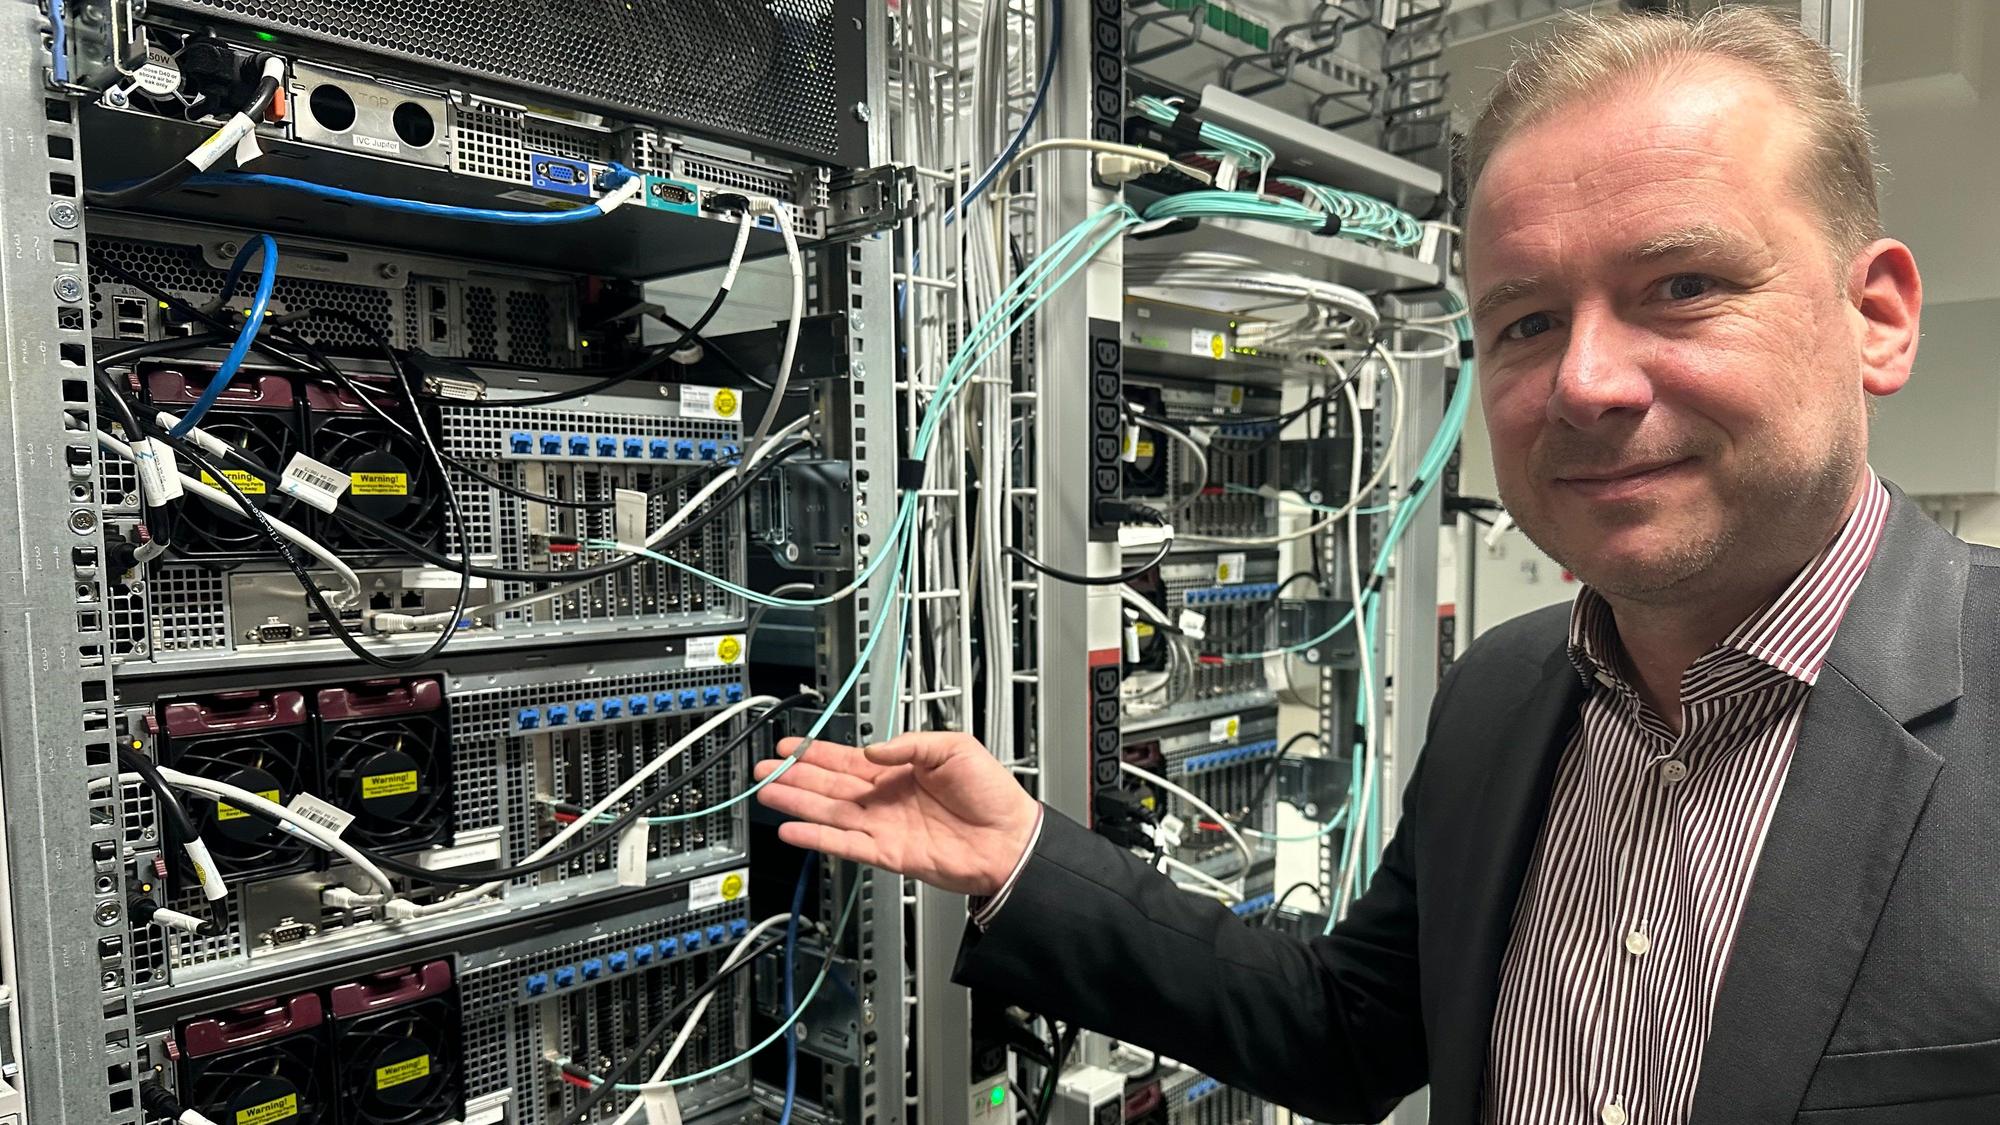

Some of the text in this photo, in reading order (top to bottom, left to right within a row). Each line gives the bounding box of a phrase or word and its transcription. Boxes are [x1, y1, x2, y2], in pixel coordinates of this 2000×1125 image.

[356, 136, 370, 146] IVC
[361, 474, 399, 484] Warning!
[372, 773, 409, 785] Warning!
[385, 1059, 420, 1075] Warning!
[247, 1098, 288, 1117] Warning!
